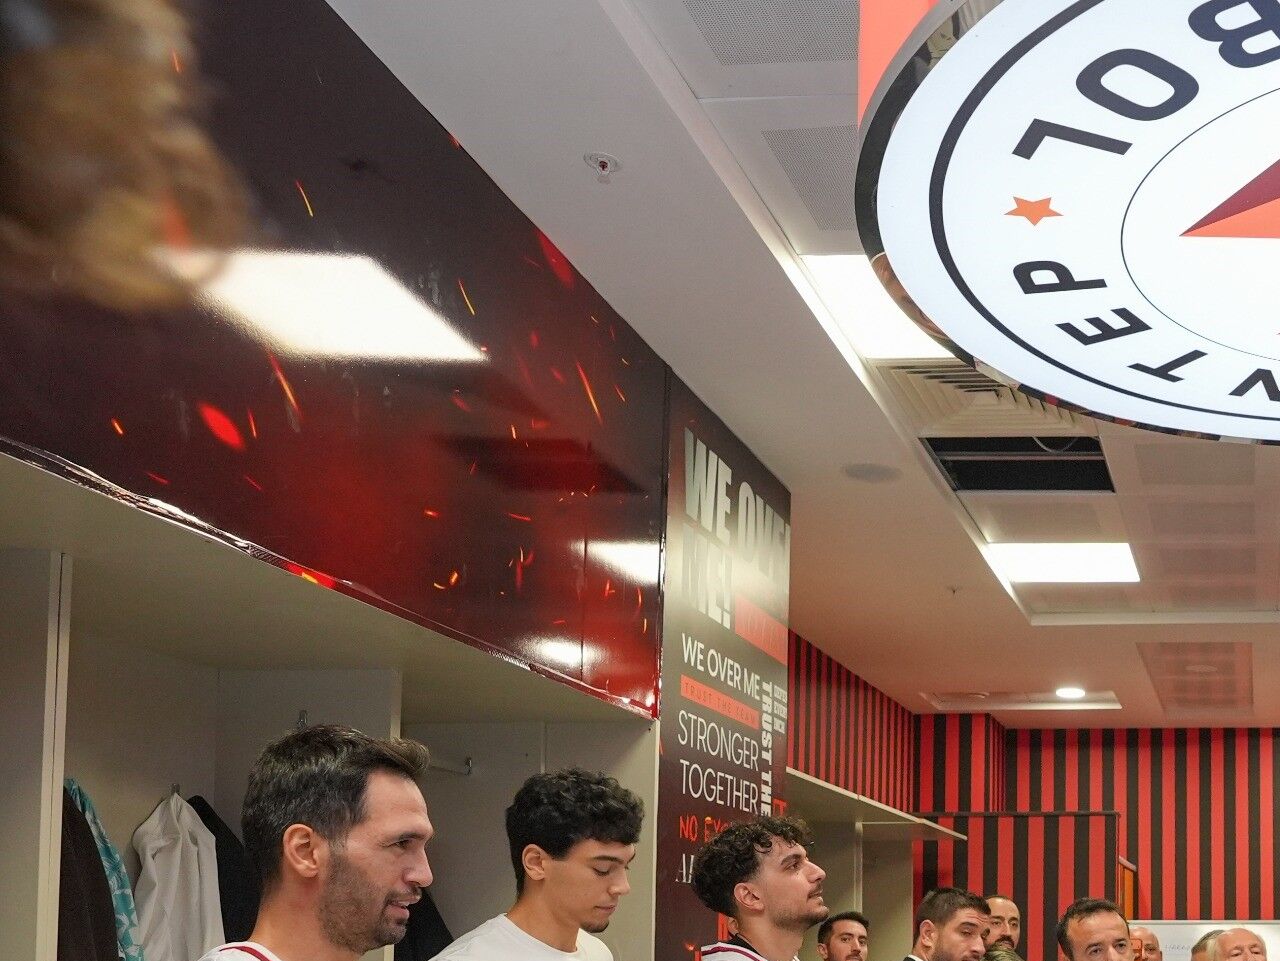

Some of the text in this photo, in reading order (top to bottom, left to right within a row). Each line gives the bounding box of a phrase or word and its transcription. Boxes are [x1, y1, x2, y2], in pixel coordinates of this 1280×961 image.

[684, 426, 732, 546] WE
[681, 632, 760, 701] WE OVER ME
[678, 709, 759, 772] STRONGER
[761, 681, 773, 766] TRUST
[679, 758, 758, 815] TOGETHER
[679, 813, 698, 842] NO
